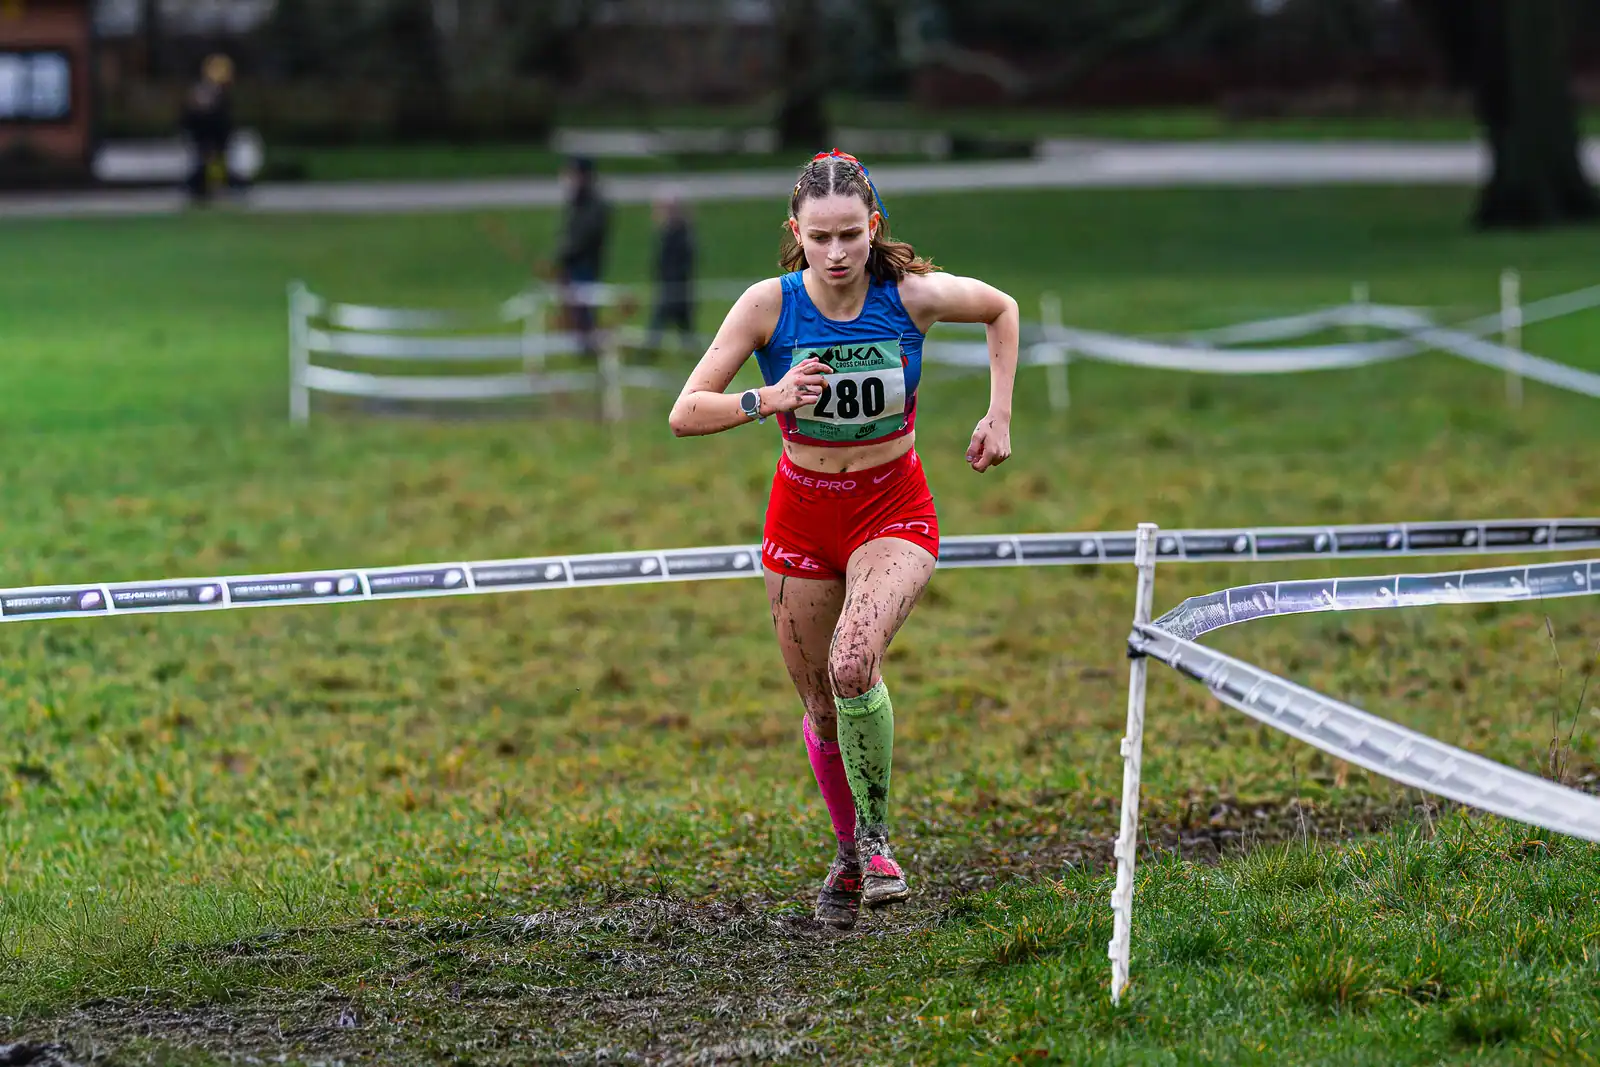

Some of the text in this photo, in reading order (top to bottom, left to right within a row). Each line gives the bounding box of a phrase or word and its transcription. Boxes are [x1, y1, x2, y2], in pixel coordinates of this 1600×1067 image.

[854, 359, 885, 367] CHALLENGE
[813, 377, 885, 419] 280
[781, 464, 857, 491] NIKE PRO
